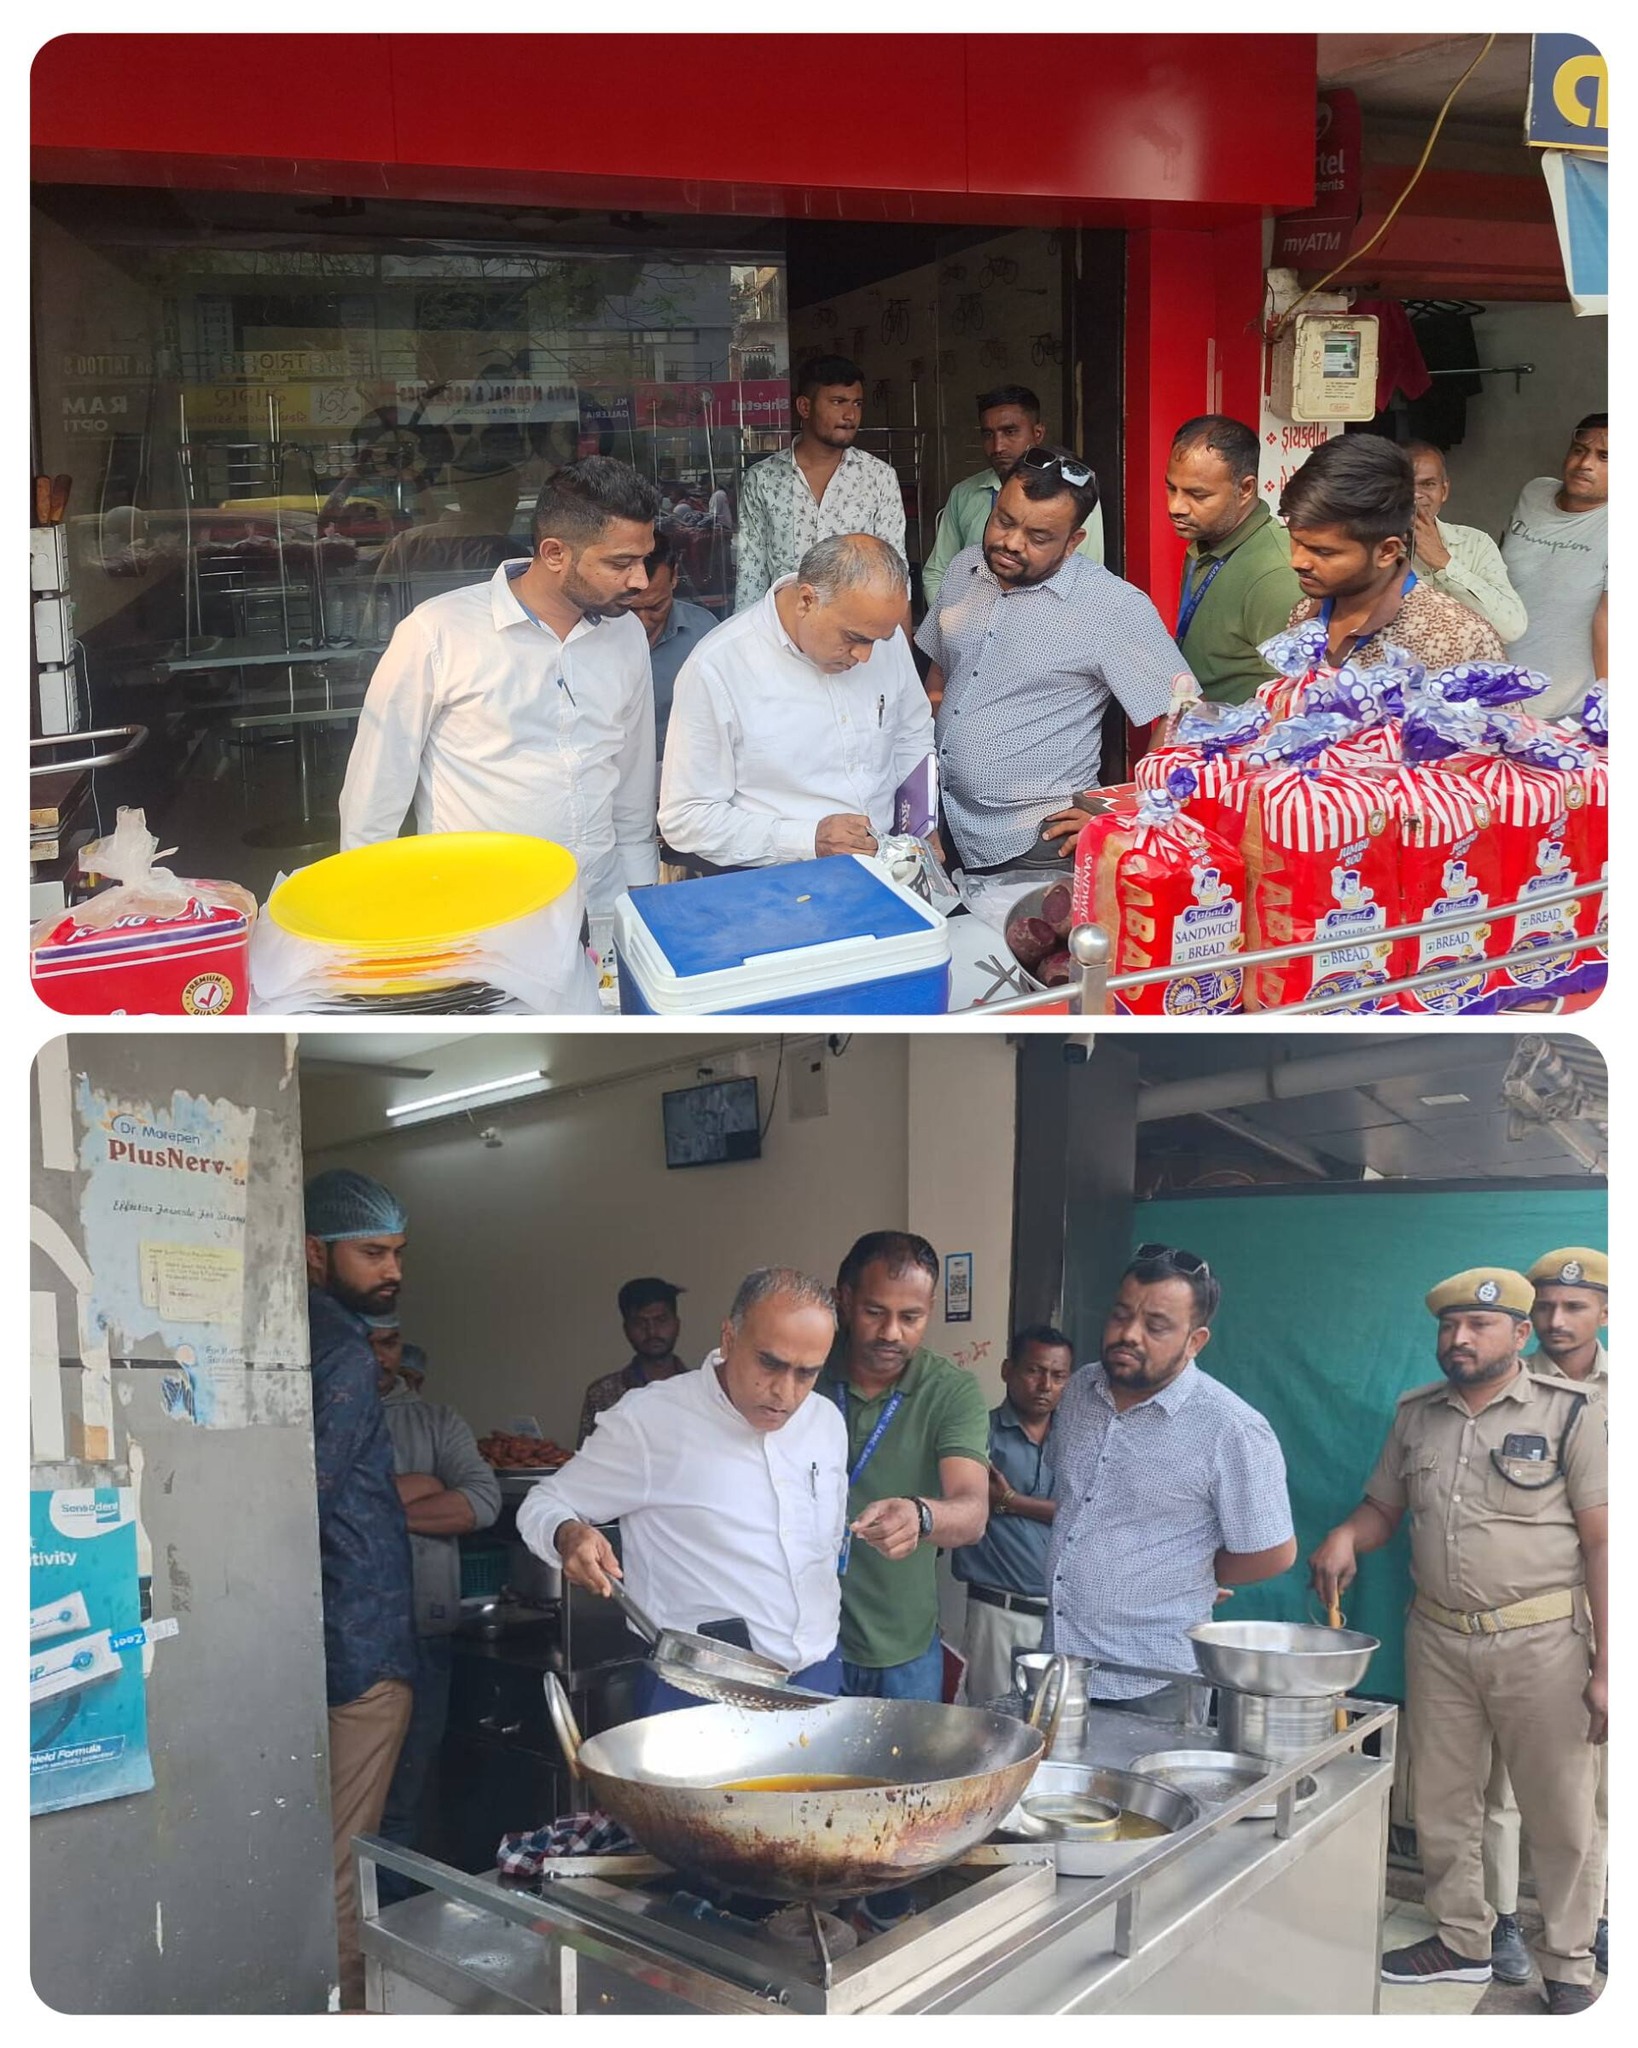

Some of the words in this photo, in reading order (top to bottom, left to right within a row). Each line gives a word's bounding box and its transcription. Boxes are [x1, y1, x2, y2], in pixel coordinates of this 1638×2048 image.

[1315, 149, 1345, 176] tel
[1283, 232, 1341, 256] myATM
[1511, 520, 1592, 554] Champion
[1336, 837, 1370, 861] JUMBO
[1080, 853, 1093, 925] SANDWIC
[1530, 908, 1562, 926] BREAD
[1175, 919, 1238, 945] SANDWICH
[1436, 931, 1470, 949] BREAD
[1188, 941, 1225, 960] BREAD
[1331, 946, 1370, 964] BREAD
[185, 975, 222, 995] PREMIUM
[193, 998, 229, 1015] QUALITY
[142, 1126, 200, 1144] Morepen
[57, 1743, 101, 1760] Formula
